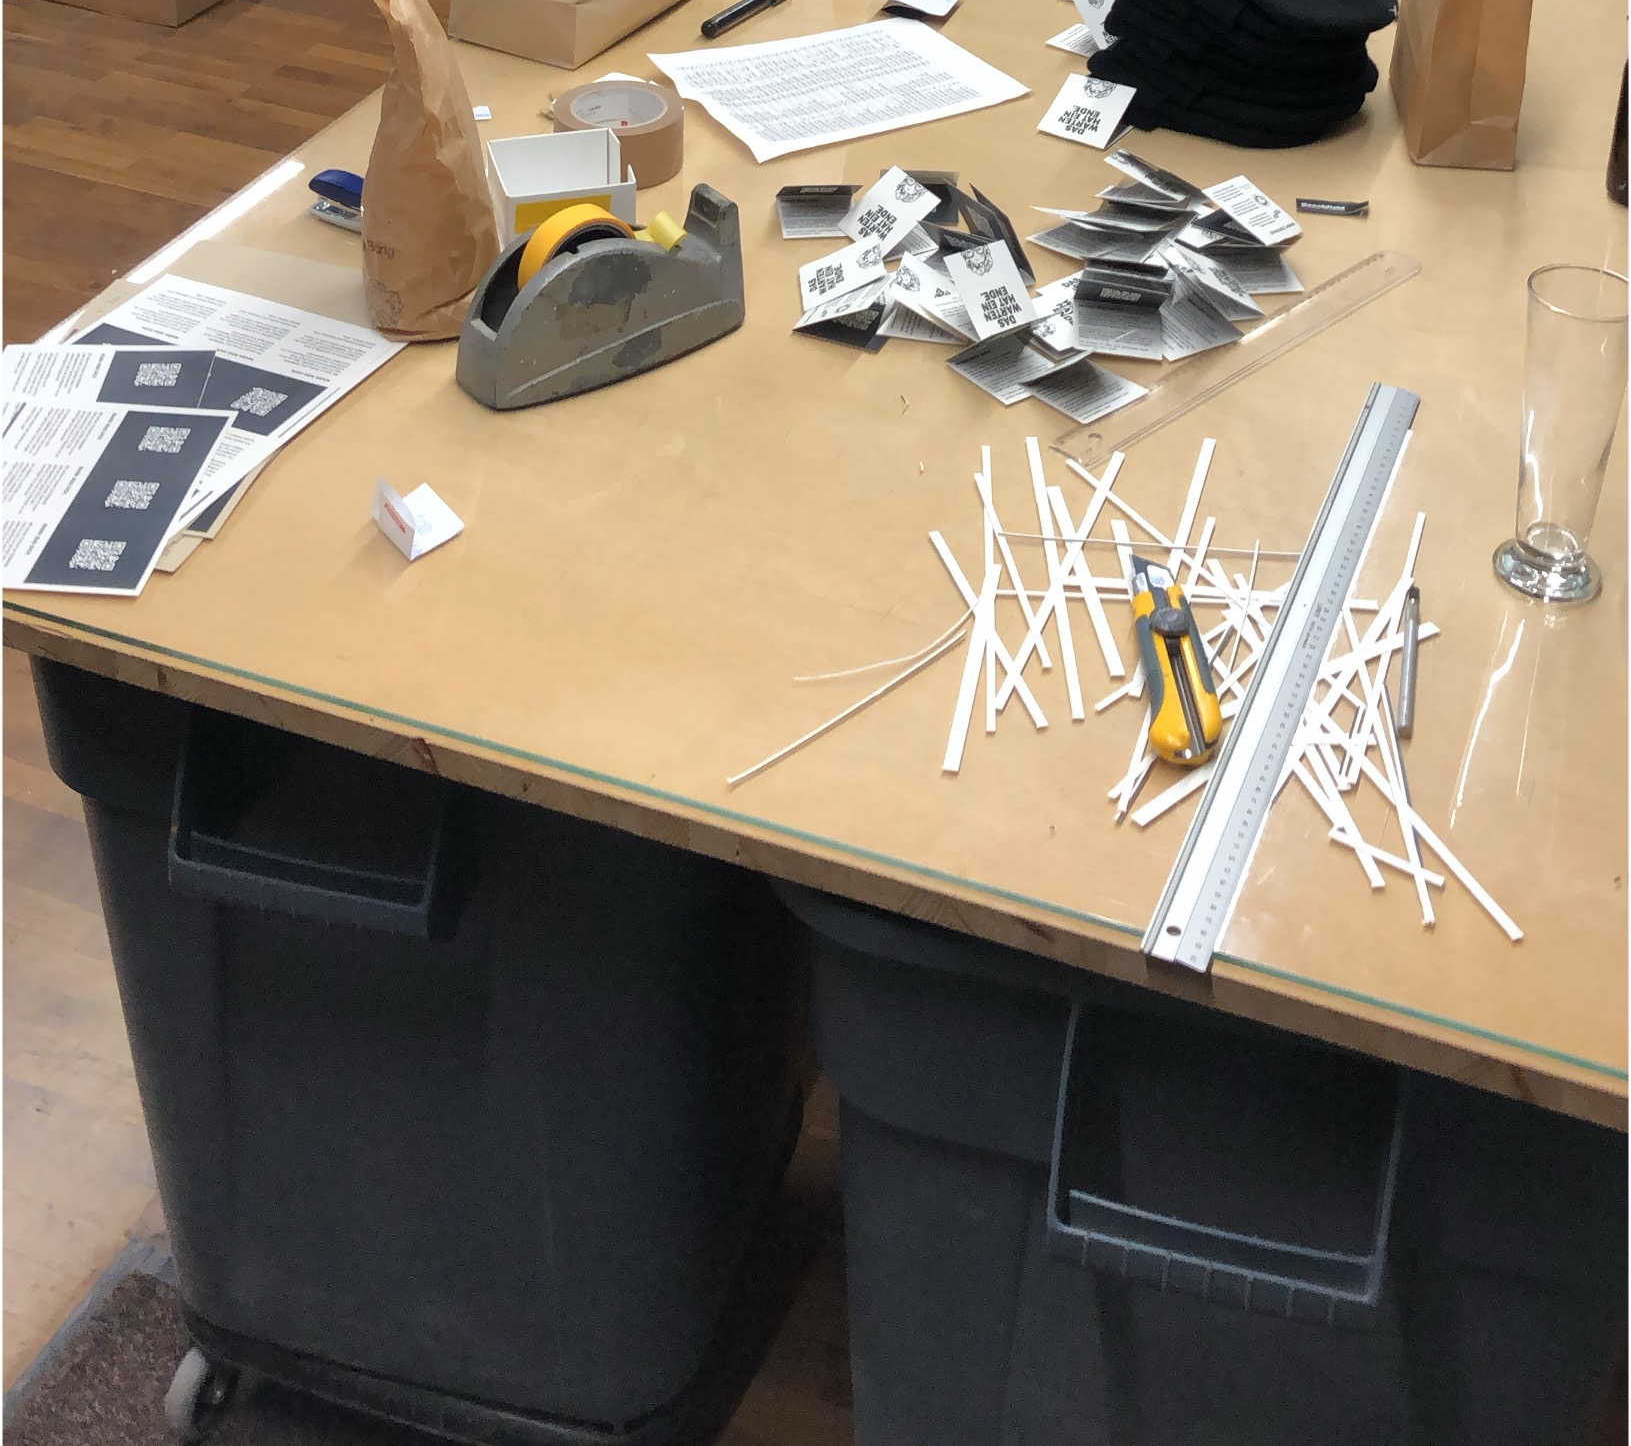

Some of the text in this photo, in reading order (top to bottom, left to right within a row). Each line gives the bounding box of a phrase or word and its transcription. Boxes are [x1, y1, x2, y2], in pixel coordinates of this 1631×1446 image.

[1058, 116, 1099, 132] WARTEN
[1063, 110, 1101, 126] HAT EIN
[1065, 125, 1085, 135] DAS
[865, 209, 893, 234] HAT EIN
[858, 227, 872, 238] AS
[808, 278, 818, 293] DAS
[980, 286, 1008, 301] ENDE.
[981, 294, 1017, 312] HAT EIN
[983, 302, 1022, 322] WARTEN
[997, 315, 1017, 328] DAS
